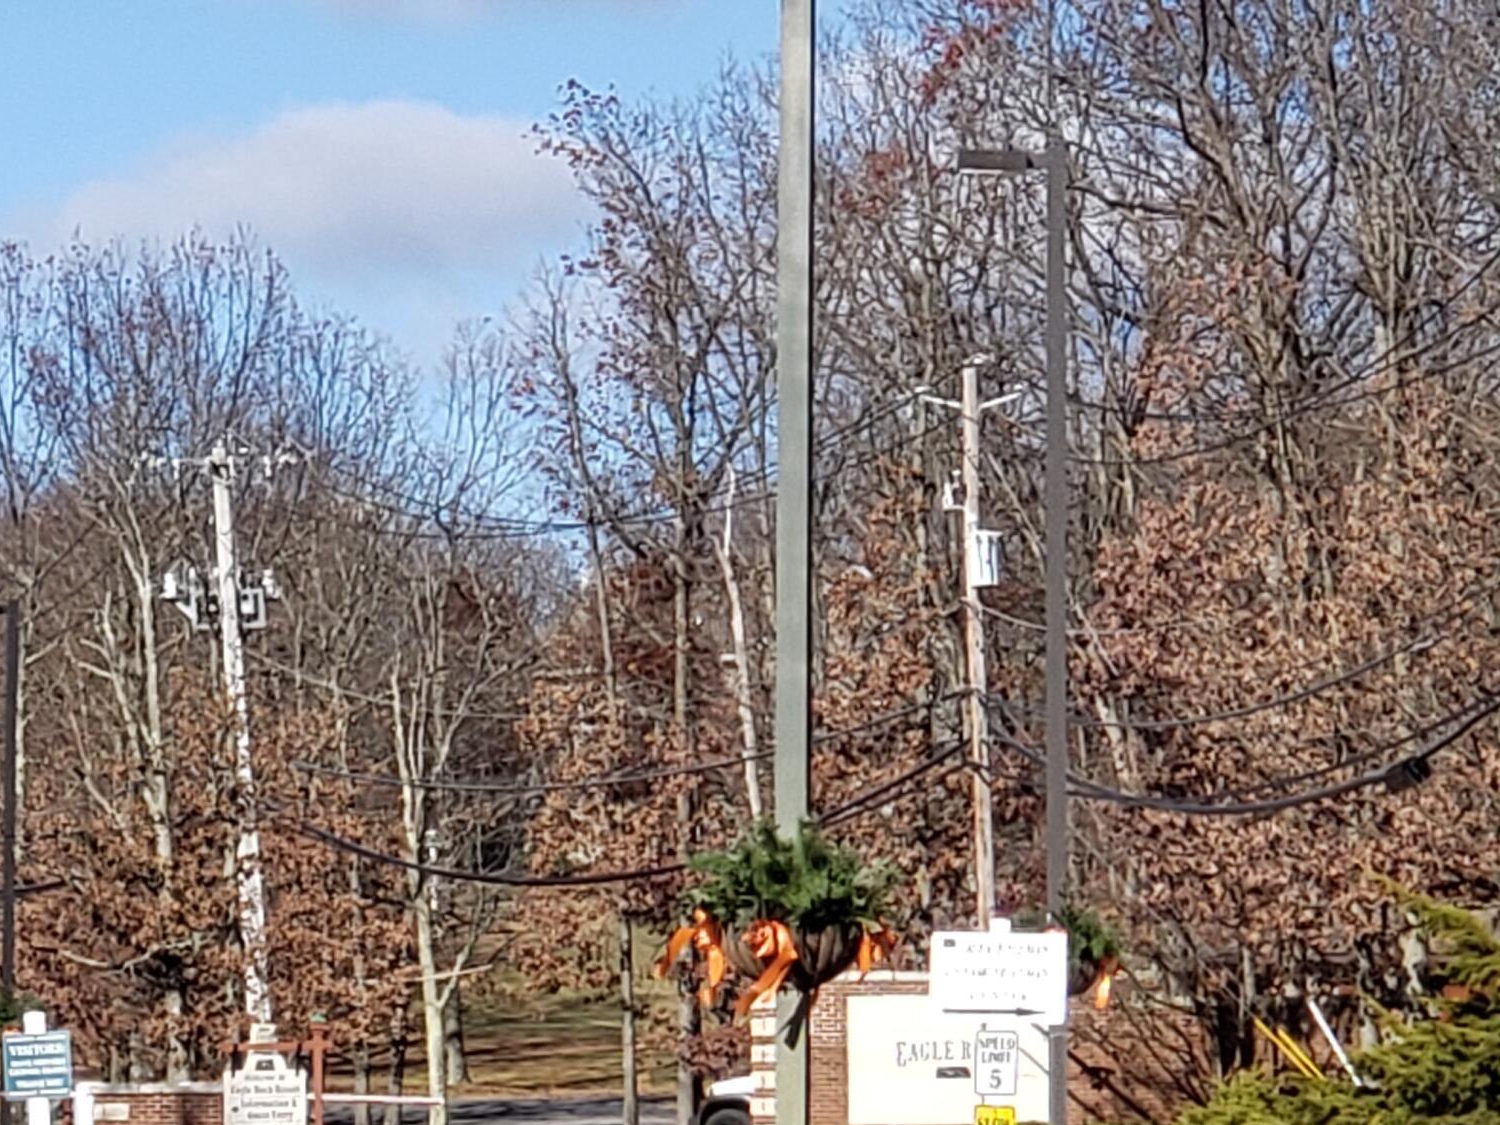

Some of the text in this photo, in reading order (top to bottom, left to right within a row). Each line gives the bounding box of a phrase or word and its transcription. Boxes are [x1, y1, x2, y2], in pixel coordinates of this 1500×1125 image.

[980, 1037, 1016, 1050] SPEED
[896, 1041, 955, 1067] EAGLE
[981, 1051, 1011, 1064] LIMIT
[989, 1068, 1002, 1089] 5
